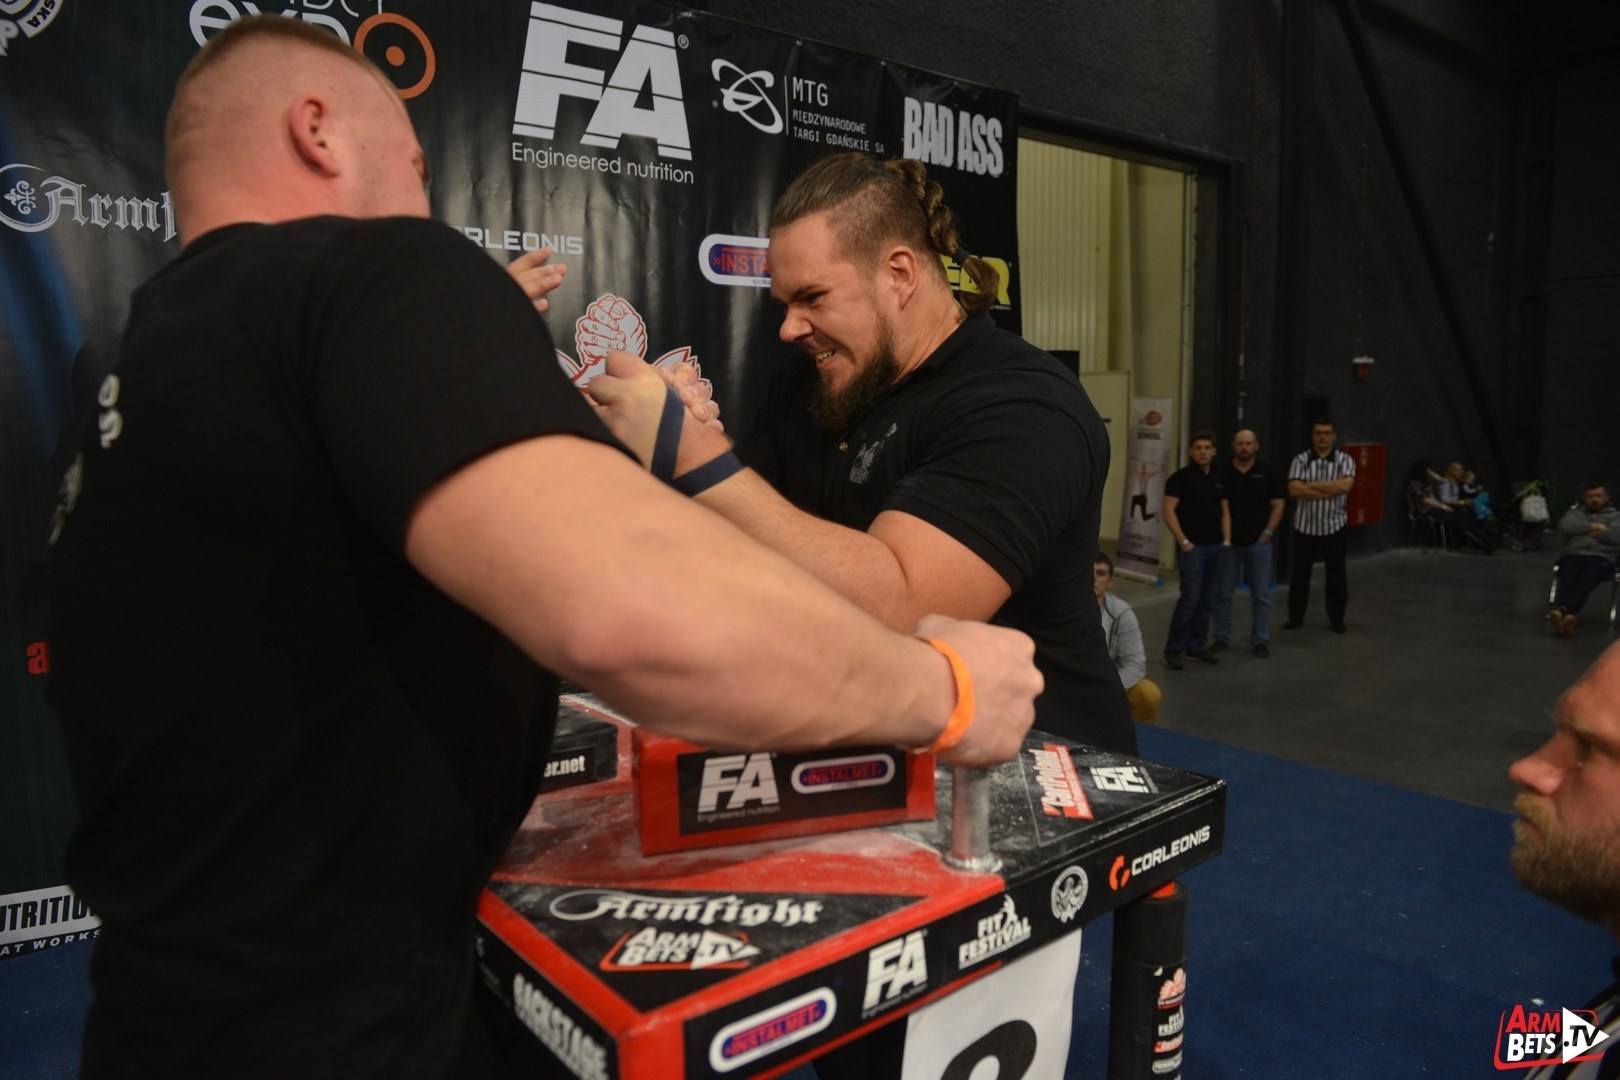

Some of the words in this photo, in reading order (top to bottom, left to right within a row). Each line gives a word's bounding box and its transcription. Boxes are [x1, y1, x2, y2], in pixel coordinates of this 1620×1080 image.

[512, 1, 692, 161] FA
[793, 76, 829, 107] MTG
[793, 109, 866, 134] MIĘDZYNARODOWE
[793, 126, 820, 142] TARGI
[826, 132, 870, 151] GDAŃSKIE
[875, 143, 885, 154] SA
[903, 96, 954, 167] BAD
[957, 110, 1004, 178] ASS
[512, 142, 621, 175] Engineered
[627, 161, 694, 184] nutrition
[698, 752, 779, 813] FA
[1131, 825, 1211, 876] CORLEONIS
[555, 889, 825, 927] Armfight
[978, 911, 1003, 938] FIT
[625, 926, 698, 949] ARM
[959, 916, 1032, 965] FESTIVAL
[862, 930, 928, 1012] FA
